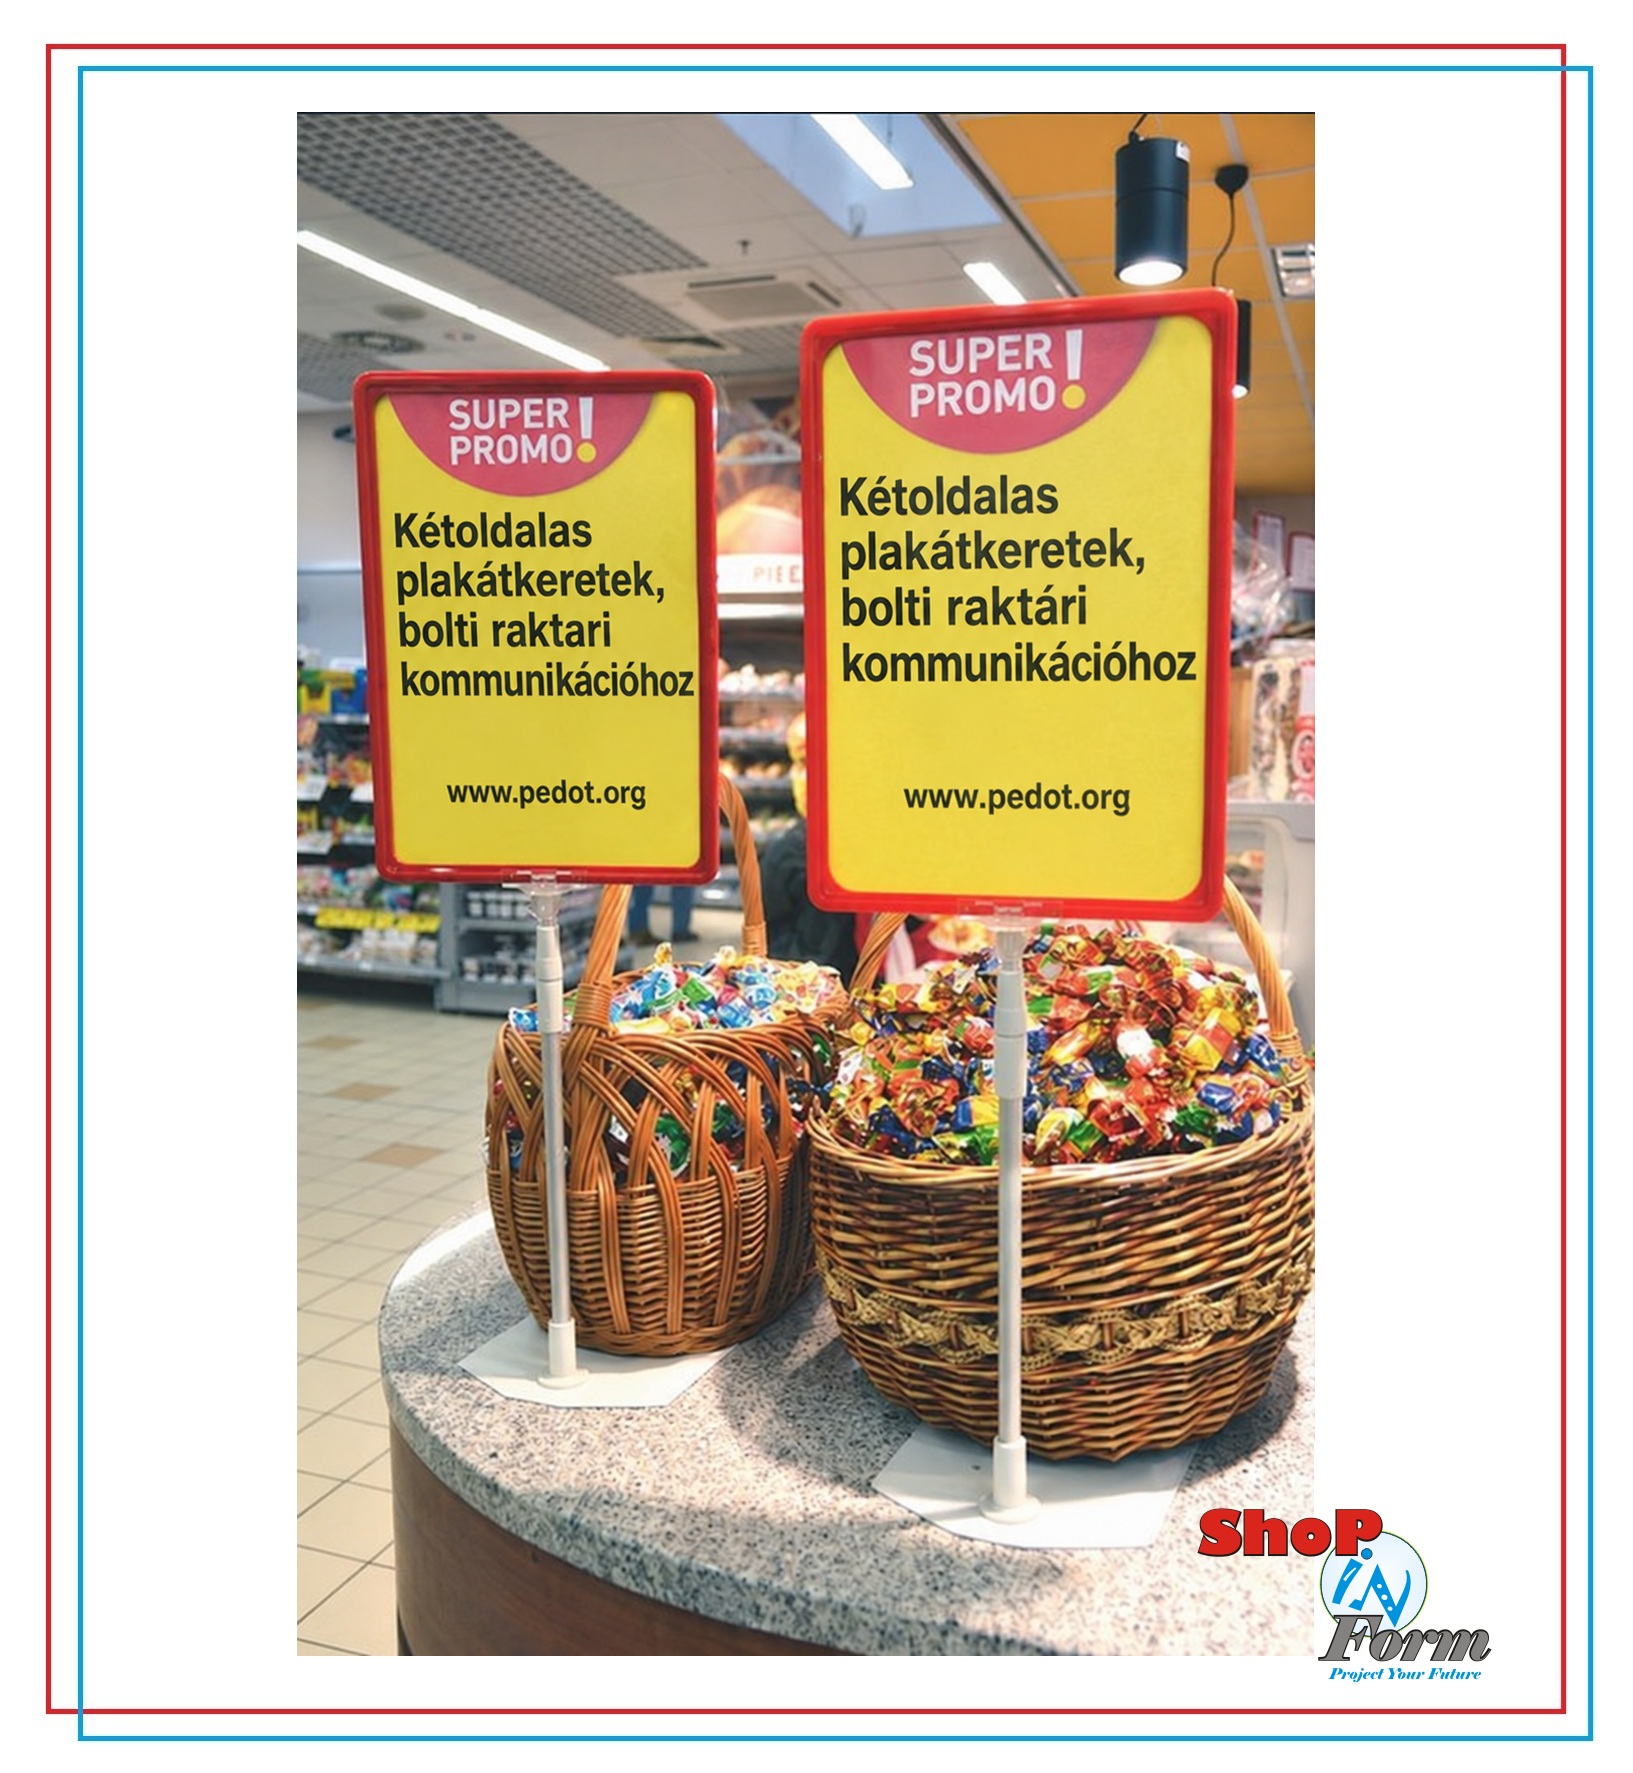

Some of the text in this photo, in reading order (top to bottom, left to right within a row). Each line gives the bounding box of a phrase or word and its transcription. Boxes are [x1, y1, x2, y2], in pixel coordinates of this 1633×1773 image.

[909, 333, 1054, 375] SUPER
[448, 397, 569, 431] SUPER
[840, 474, 1059, 517] Kétoldalas
[394, 511, 592, 549] Kétoldalas
[841, 527, 1145, 580] plakátkeretek,
[396, 560, 665, 606] plakátkeretek,
[842, 584, 1087, 627] bolti raktári
[398, 610, 611, 648] bolti raktari
[400, 660, 695, 697] kommunikációhoz
[842, 640, 1197, 683] kommunikációhoz
[446, 779, 647, 811] www.pedot.org
[903, 782, 1131, 817] www.pedot.org
